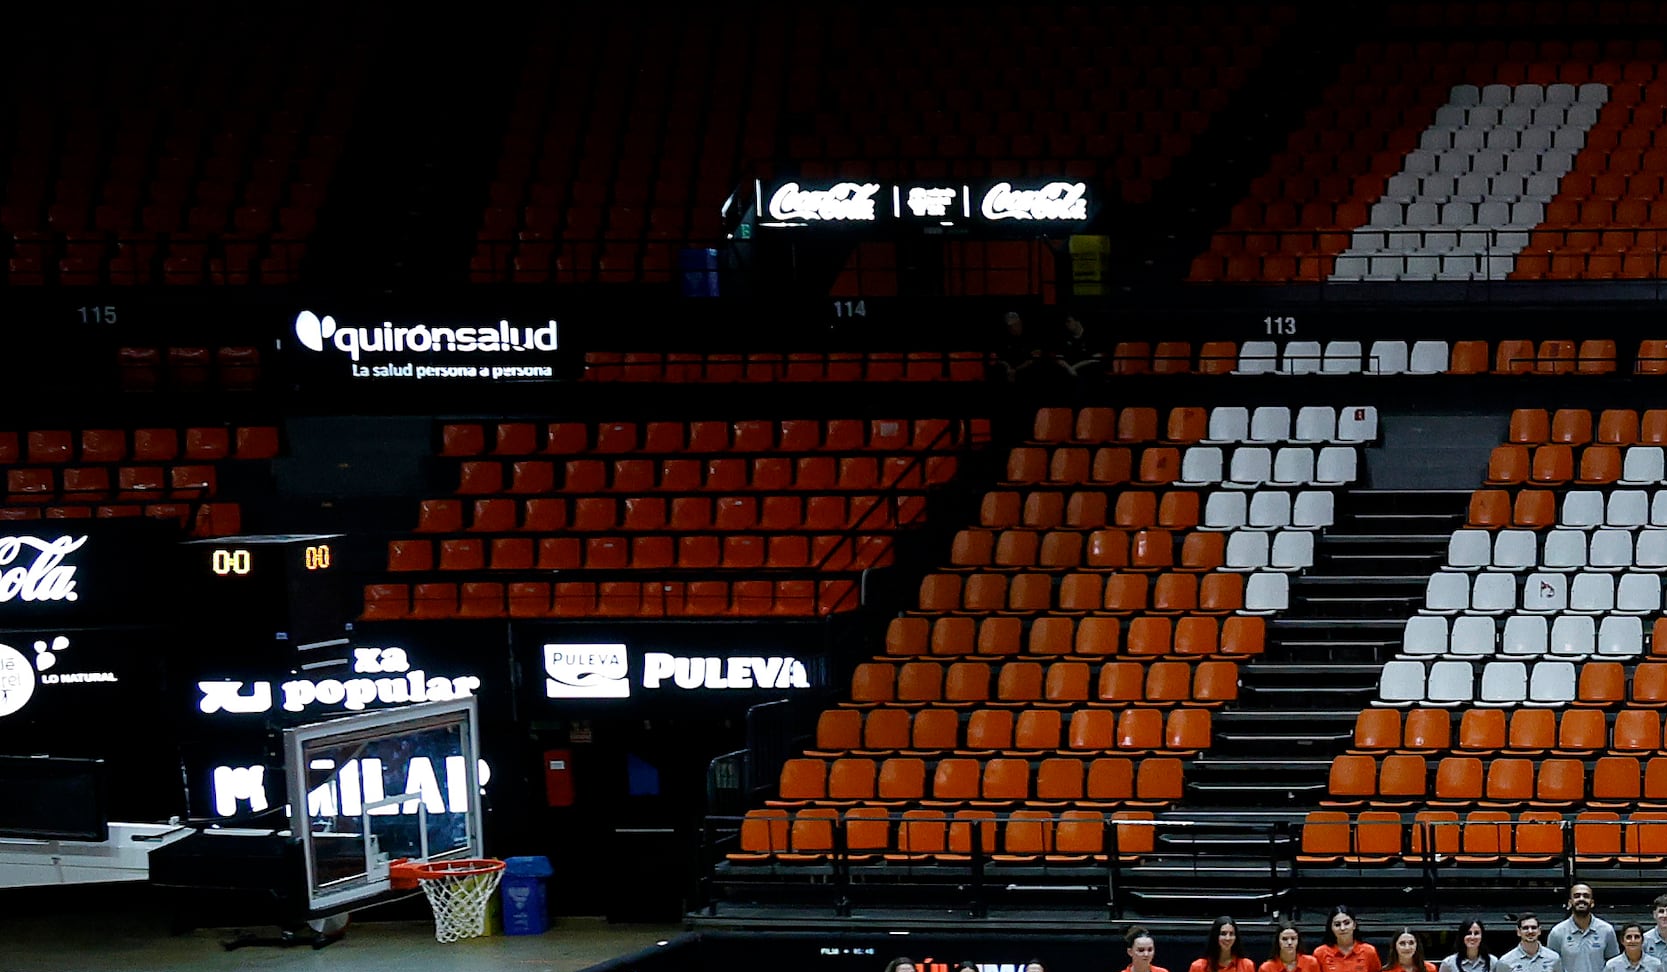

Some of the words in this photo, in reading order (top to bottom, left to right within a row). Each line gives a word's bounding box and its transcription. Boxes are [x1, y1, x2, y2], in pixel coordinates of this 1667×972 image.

[80, 307, 115, 323] 115
[835, 301, 864, 316] 114
[1264, 317, 1295, 334] 113
[334, 320, 558, 361] quirónsalud
[352, 363, 368, 377] La
[373, 363, 413, 377] salud
[416, 366, 476, 378] persona
[479, 367, 489, 377] a
[643, 652, 810, 689] PULEVA
[282, 670, 480, 711] popular
